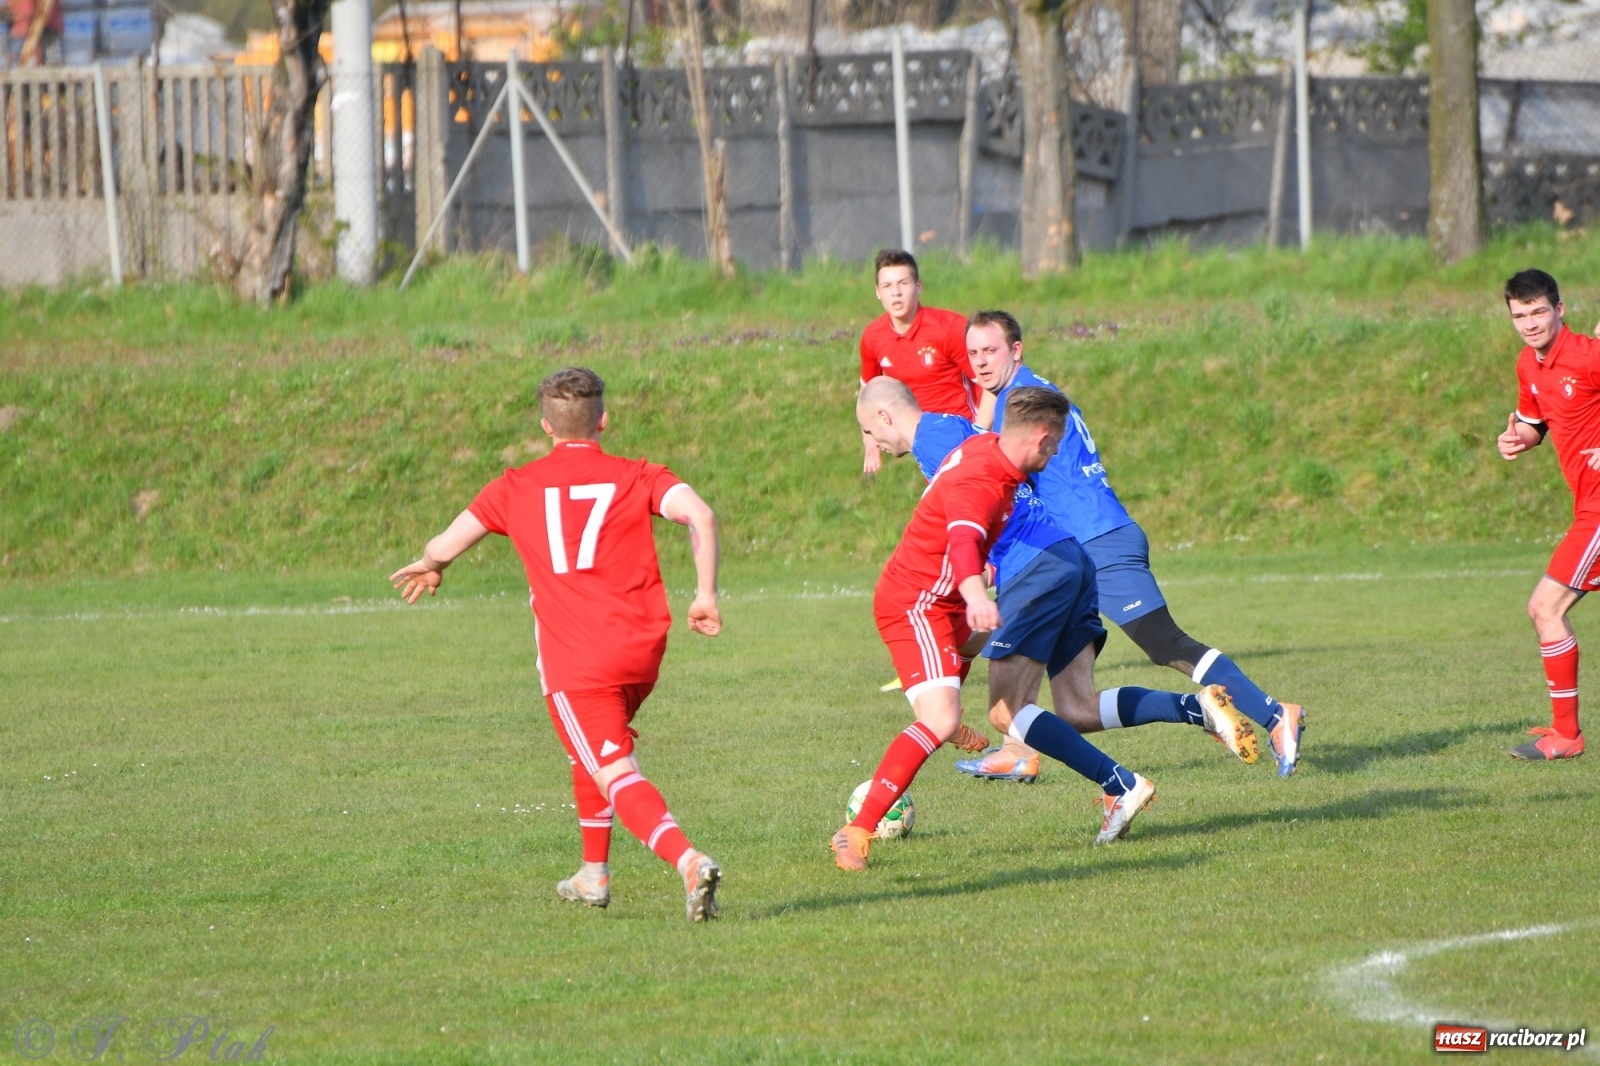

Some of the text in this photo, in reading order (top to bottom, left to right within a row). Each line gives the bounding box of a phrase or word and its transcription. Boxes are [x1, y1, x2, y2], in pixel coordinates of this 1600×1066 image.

[1565, 384, 1572, 397] 9
[544, 482, 617, 574] 17
[1122, 600, 1142, 612] COLO
[990, 640, 1012, 649] COLO
